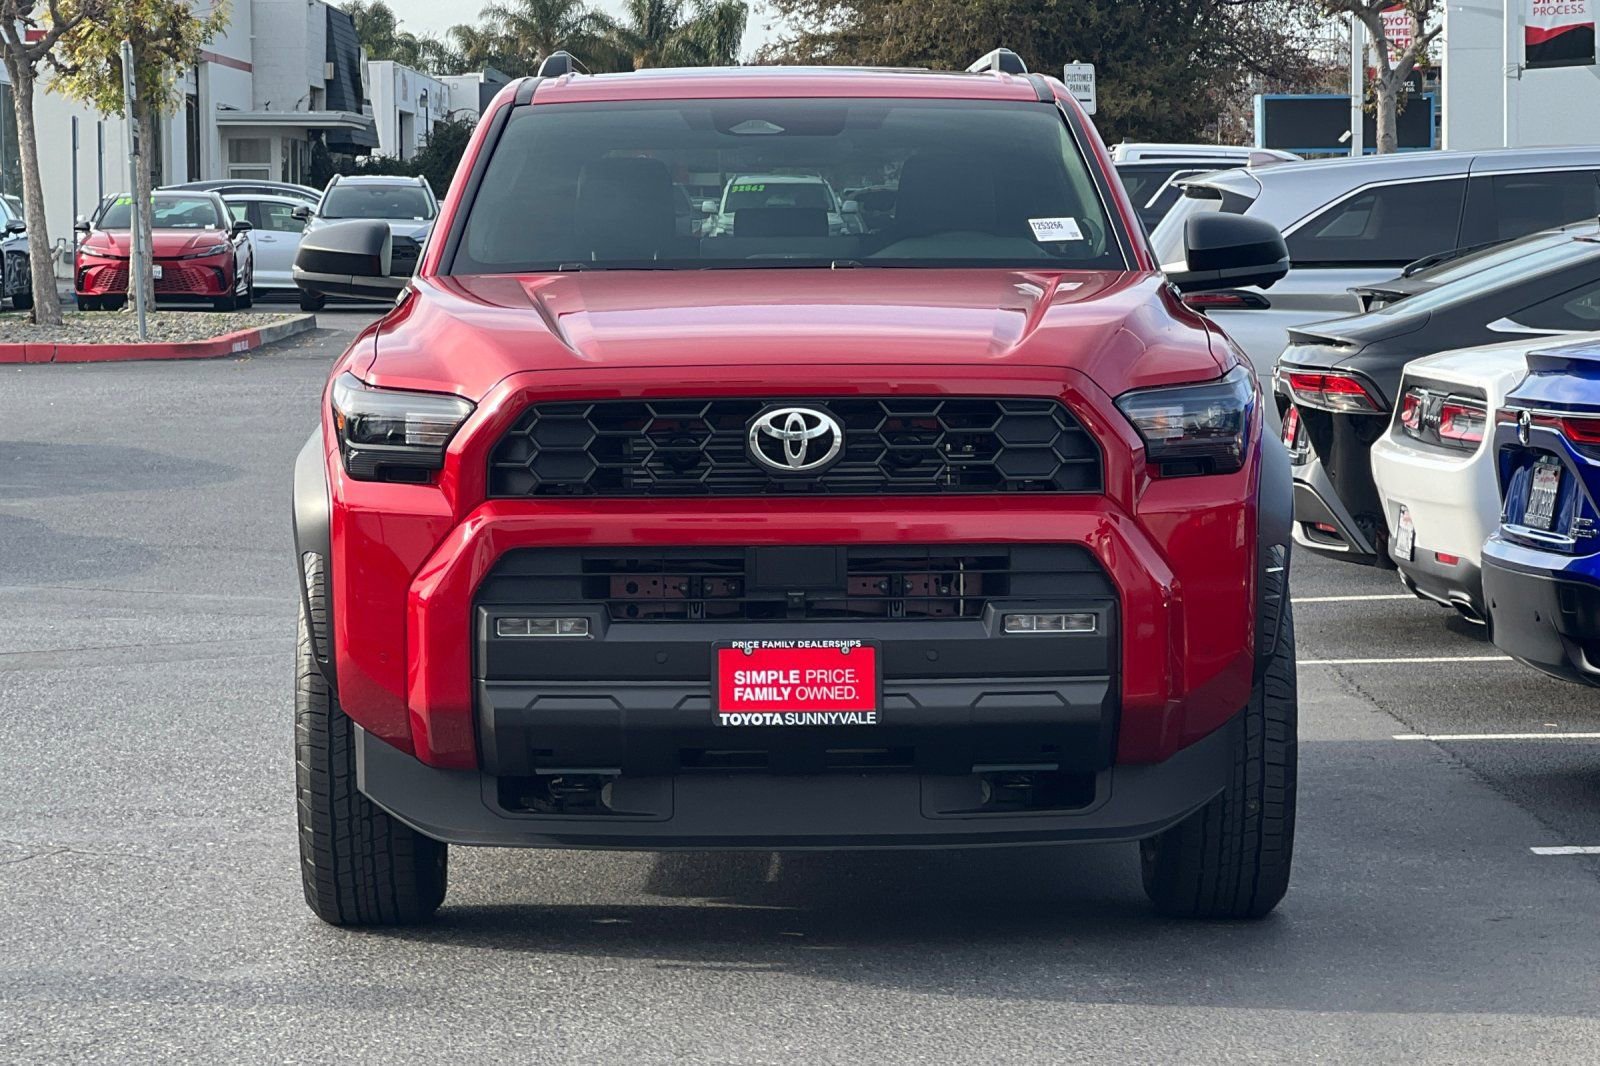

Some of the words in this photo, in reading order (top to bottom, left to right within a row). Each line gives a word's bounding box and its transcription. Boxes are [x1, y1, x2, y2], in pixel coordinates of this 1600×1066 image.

[1067, 73, 1093, 82] CUSTOMER
[1070, 83, 1091, 92] PARKING
[732, 640, 760, 649] PRICE
[762, 640, 795, 648] FAMILY
[798, 639, 862, 648] DEALERSHIPS
[734, 669, 800, 685] SIMPLE
[805, 668, 859, 684] PRICE.
[734, 686, 792, 701] FAMILY
[795, 685, 859, 701] OWNED.
[719, 712, 783, 726] TOYOTA
[784, 711, 877, 725] SUNNYVALE
